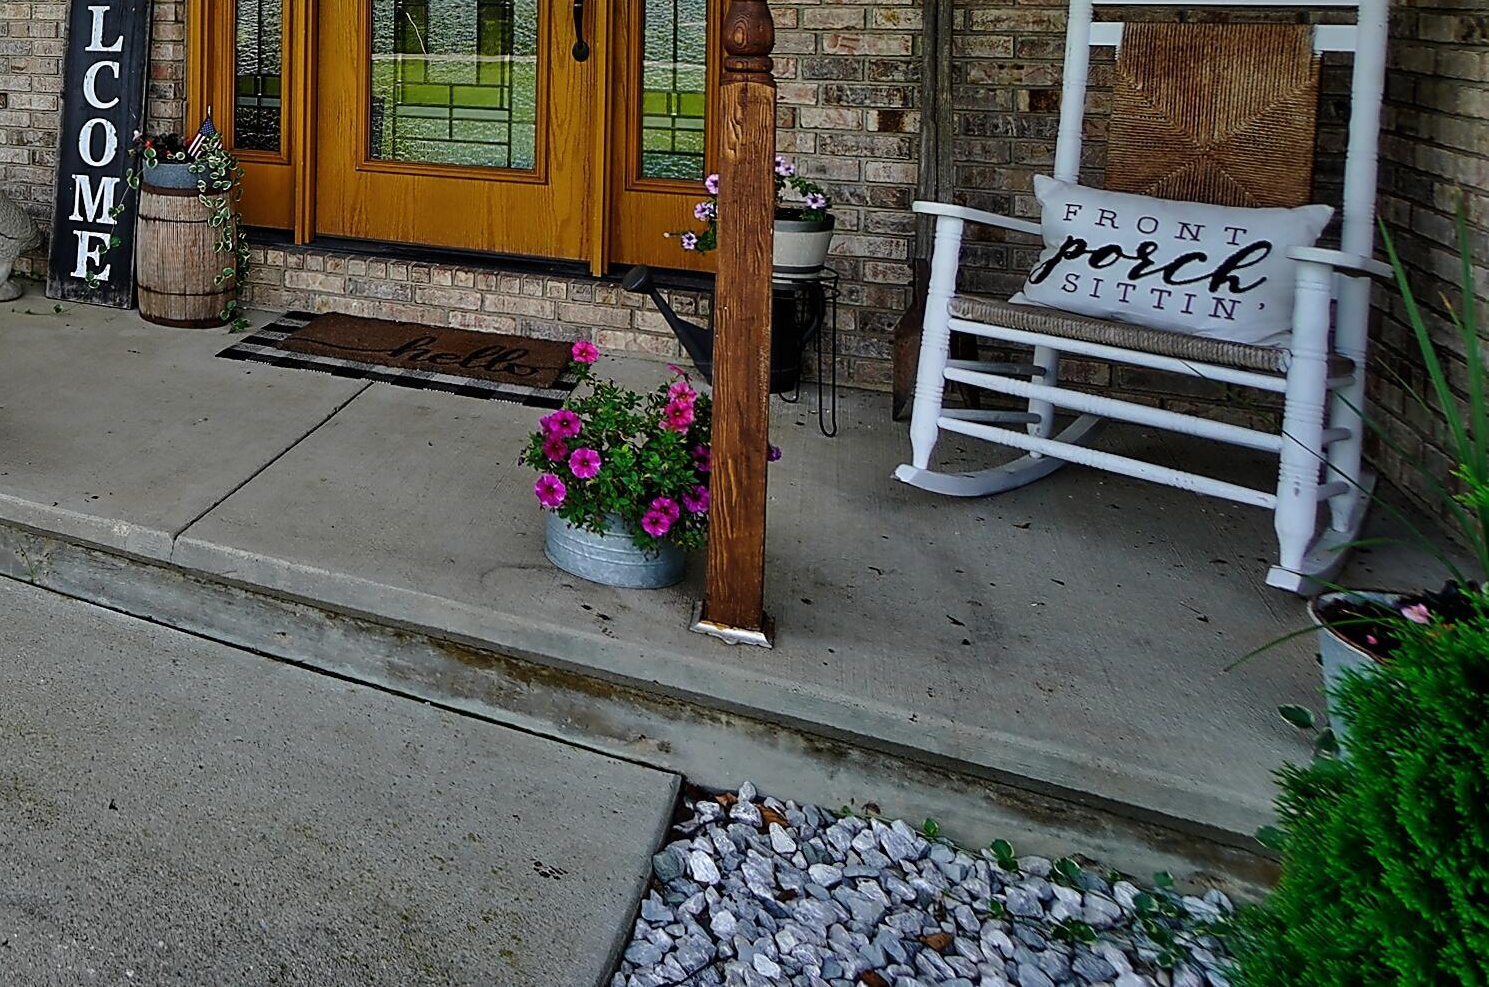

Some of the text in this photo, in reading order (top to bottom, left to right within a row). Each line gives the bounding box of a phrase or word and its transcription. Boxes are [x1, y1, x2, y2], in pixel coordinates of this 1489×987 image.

[1063, 203, 1247, 246] FRONT
[1028, 234, 1273, 294] porch
[1061, 273, 1265, 320] SITTIN'
[387, 336, 539, 376] hello
